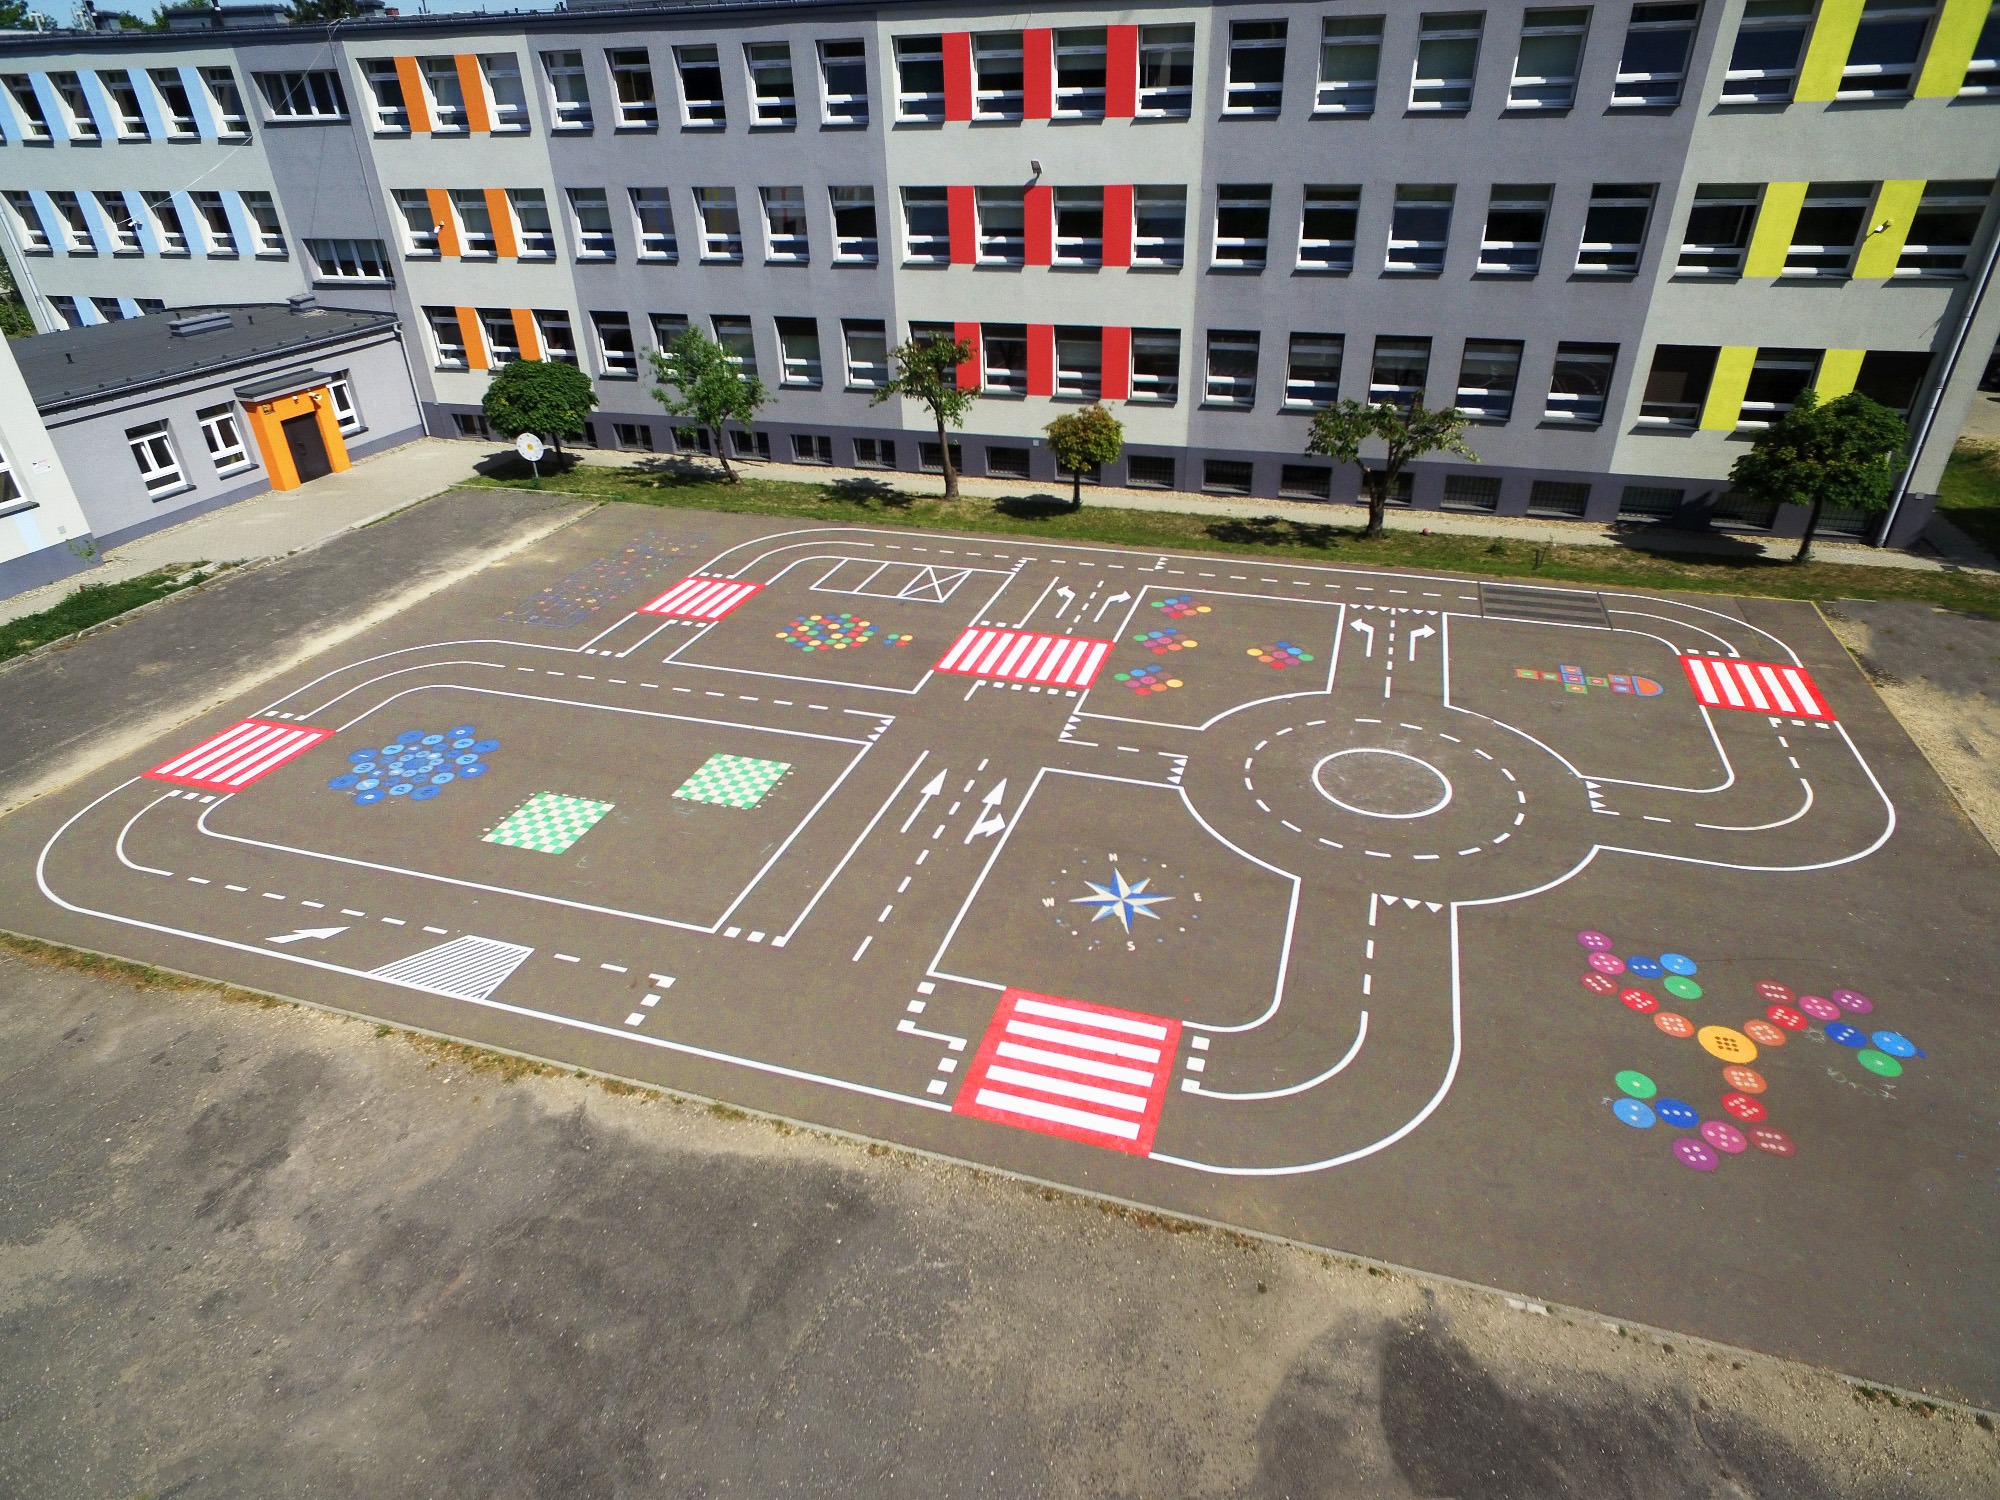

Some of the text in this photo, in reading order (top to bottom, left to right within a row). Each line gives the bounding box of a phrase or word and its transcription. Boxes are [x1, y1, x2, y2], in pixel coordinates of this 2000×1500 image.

[1108, 853, 1118, 862] N
[1193, 892, 1203, 902] E
[1042, 897, 1055, 908] W
[1126, 941, 1136, 951] S
